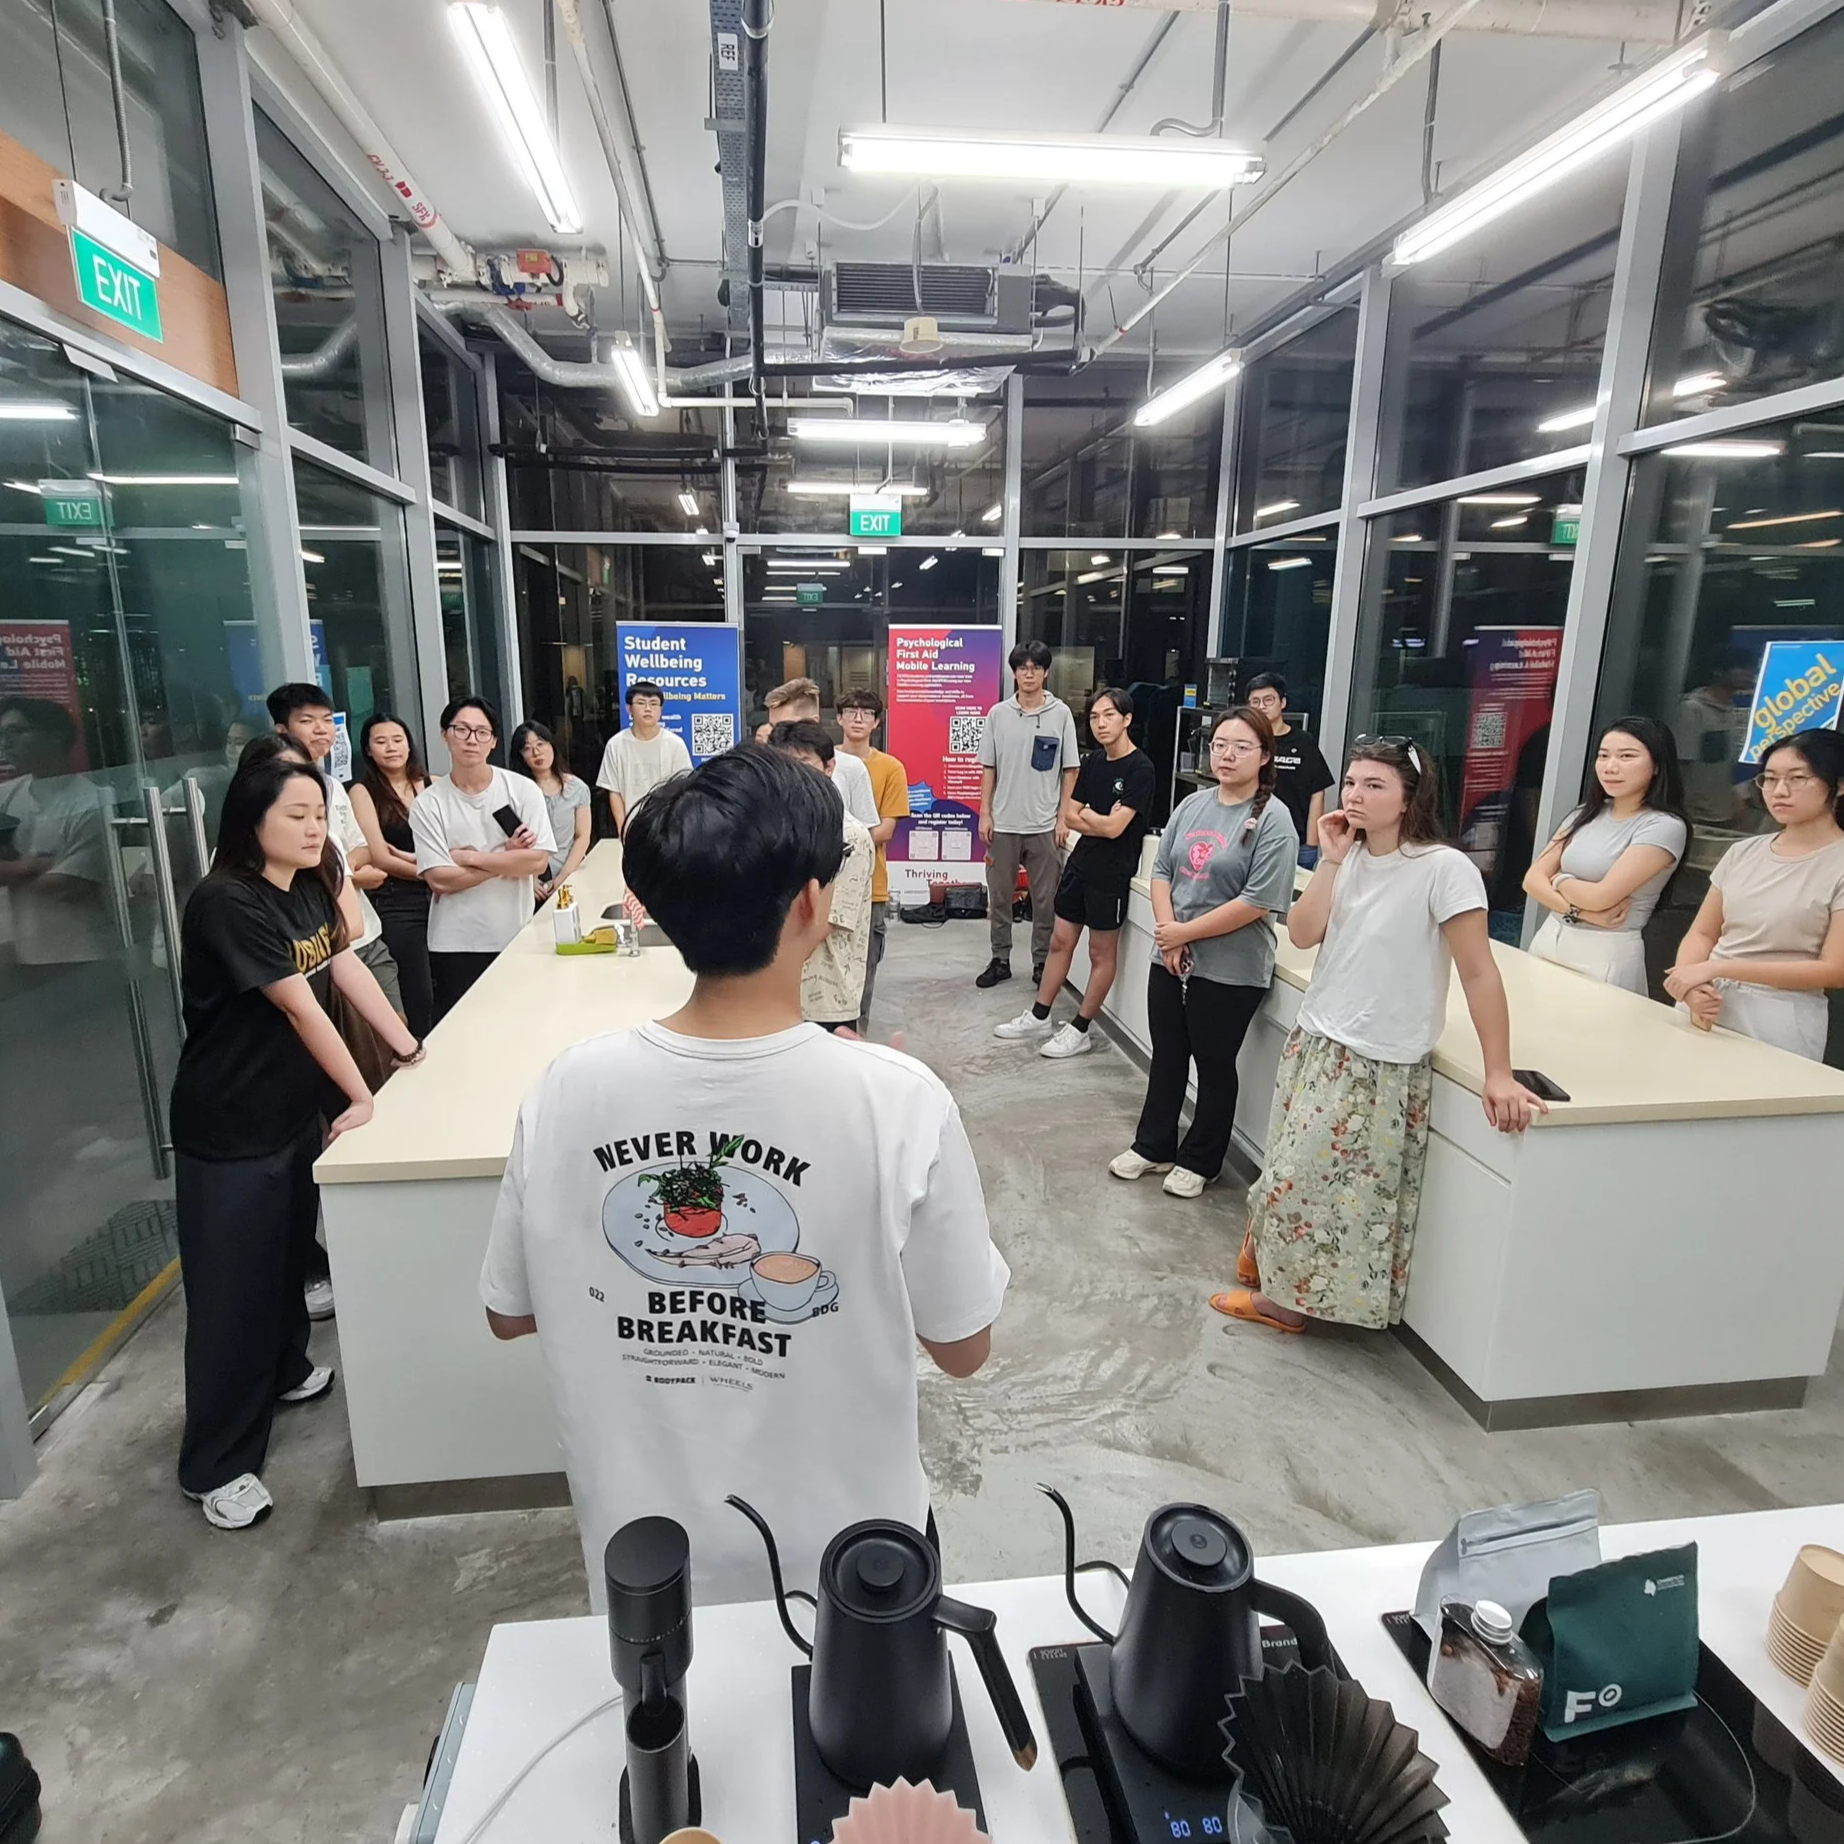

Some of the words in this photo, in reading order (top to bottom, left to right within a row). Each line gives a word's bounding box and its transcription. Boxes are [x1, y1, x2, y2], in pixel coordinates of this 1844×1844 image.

[720, 43, 735, 61] REF
[92, 254, 142, 321] EXIT
[860, 514, 890, 532] EXIT
[624, 636, 686, 651] Student
[896, 637, 963, 649] Psychological
[624, 653, 702, 672] Wellbeing
[896, 649, 919, 659] First
[922, 649, 939, 659] Aid
[896, 661, 928, 671] Mobile
[931, 661, 975, 672] Learning
[694, 692, 726, 700] Matters
[1755, 652, 1837, 734] global
[905, 869, 948, 881] Thriving
[593, 1130, 697, 1172] NEVER
[709, 1131, 811, 1187] WORK
[588, 1286, 605, 1303] 022
[647, 1290, 767, 1324] BEFORE
[812, 1302, 839, 1318] BDG
[617, 1316, 792, 1357] BREAKFAST
[643, 1348, 689, 1357] GROUNDED
[699, 1349, 734, 1360] NATURAL
[743, 1355, 764, 1366] BOLD
[622, 1353, 700, 1367] STRAIGHTFORWARD
[709, 1360, 743, 1370] ELEGANT
[751, 1368, 786, 1380] MODERN
[1262, 1637, 1298, 1649] Brand
[1170, 1820, 1191, 1839] 80
[1202, 1816, 1223, 1835] 80
